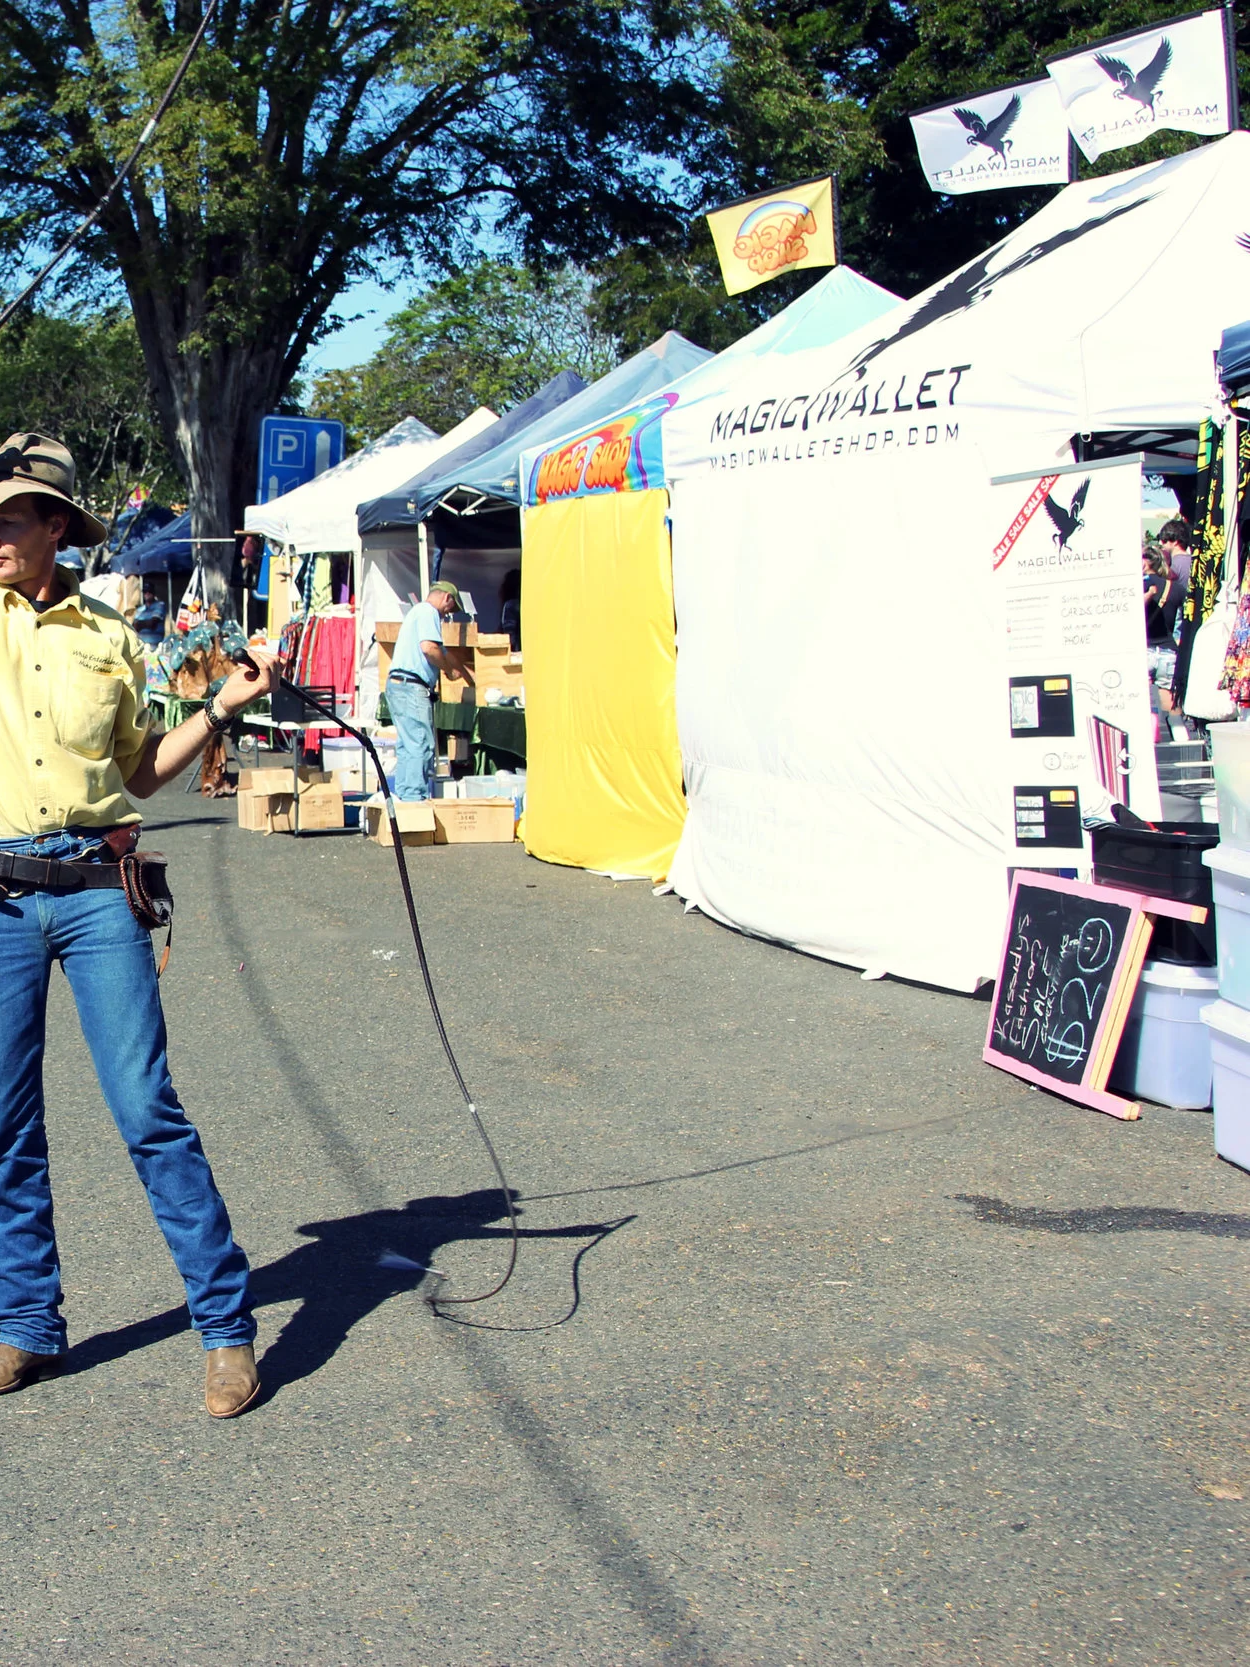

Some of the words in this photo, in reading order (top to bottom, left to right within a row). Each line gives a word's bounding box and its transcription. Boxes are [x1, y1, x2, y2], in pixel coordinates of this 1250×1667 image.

[710, 395, 809, 443] MAGIC
[816, 364, 972, 424] WALLET
[277, 434, 298, 462] P
[535, 443, 587, 498] MAGIC
[584, 435, 632, 489] SHOP
[710, 423, 960, 471] MAGICWALLETSHOP.COM
[1008, 514, 1026, 540] SALE
[1023, 488, 1043, 518] SALE
[1040, 474, 1057, 492] SAL
[1017, 554, 1056, 569] MAGIC
[1063, 548, 1115, 563] WALLET
[1009, 939, 1042, 1046] Fashion
[1021, 945, 1052, 1059] SALE
